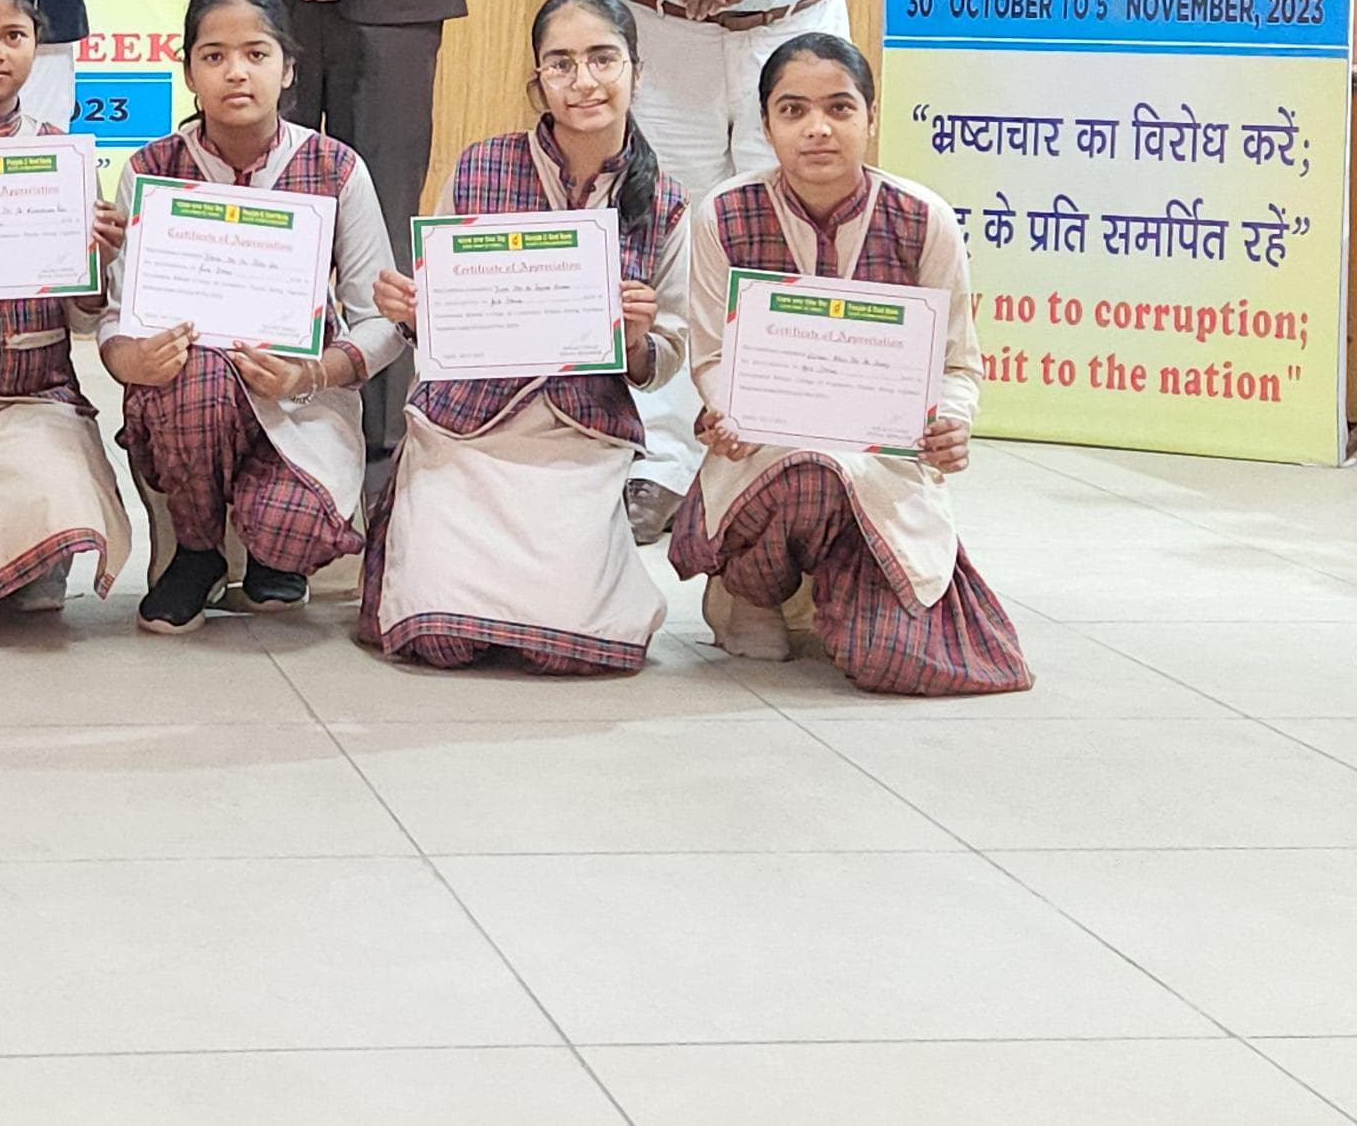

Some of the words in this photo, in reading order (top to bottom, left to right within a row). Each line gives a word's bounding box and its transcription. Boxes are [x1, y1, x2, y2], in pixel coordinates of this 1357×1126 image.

[76, 34, 181, 62] EEK
[1076, 118, 1119, 159] का
[1132, 102, 1228, 164] विरोध
[1242, 106, 1310, 177] करें;
[983, 191, 1017, 249] के
[1027, 194, 1090, 253] प्रति
[1101, 198, 1229, 261] समर्पित
[453, 263, 503, 276] Certificate
[516, 261, 581, 273] Appreciation
[994, 293, 1036, 323] no
[1048, 291, 1083, 325] to
[1095, 299, 1309, 351] corruption;
[1041, 352, 1076, 387] to
[1089, 353, 1145, 392] the
[1159, 358, 1301, 402] nation"
